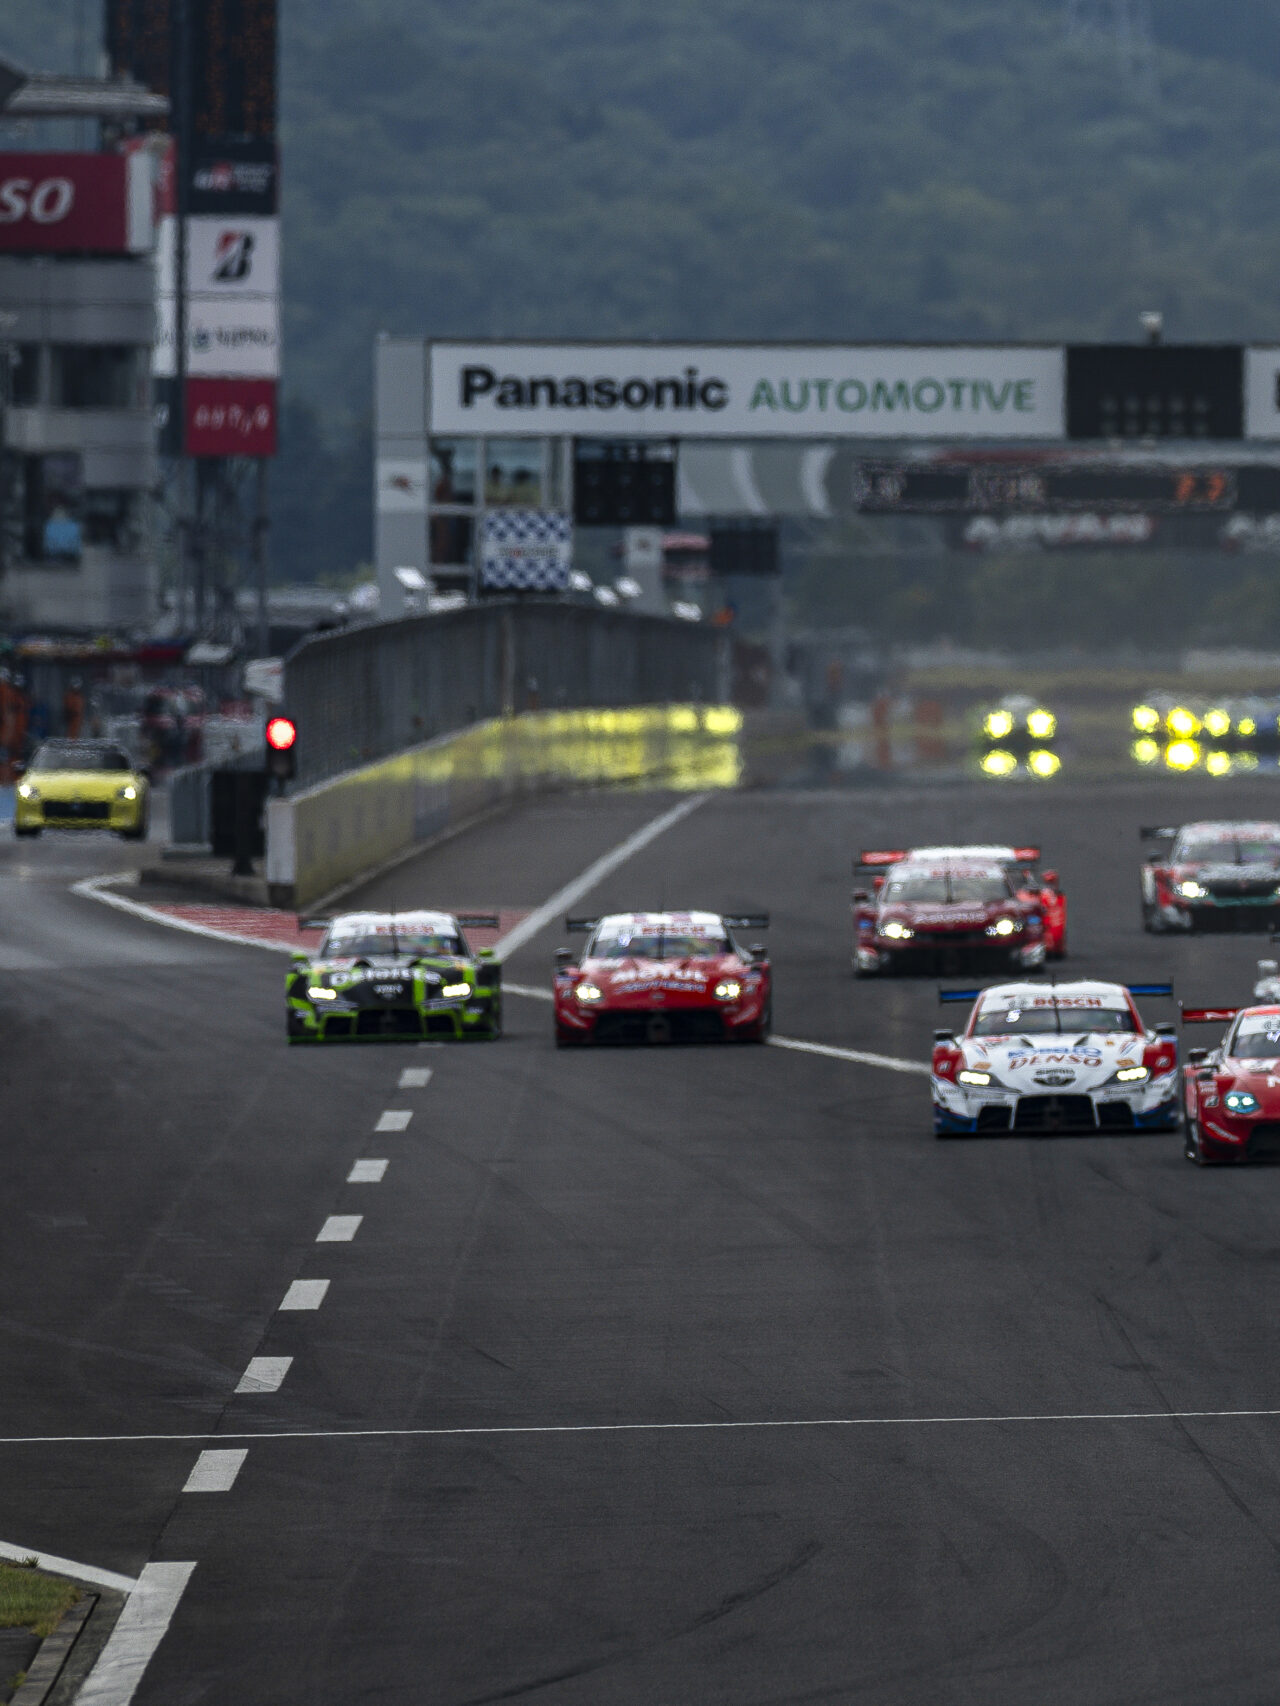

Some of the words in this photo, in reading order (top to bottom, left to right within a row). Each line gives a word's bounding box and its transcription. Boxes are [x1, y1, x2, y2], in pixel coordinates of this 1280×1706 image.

[460, 366, 729, 412] Panasonic
[748, 377, 1037, 413] AUTOMOTIVE
[1033, 997, 1102, 1007] BOSCH
[1007, 1054, 1103, 1071] DENSO
